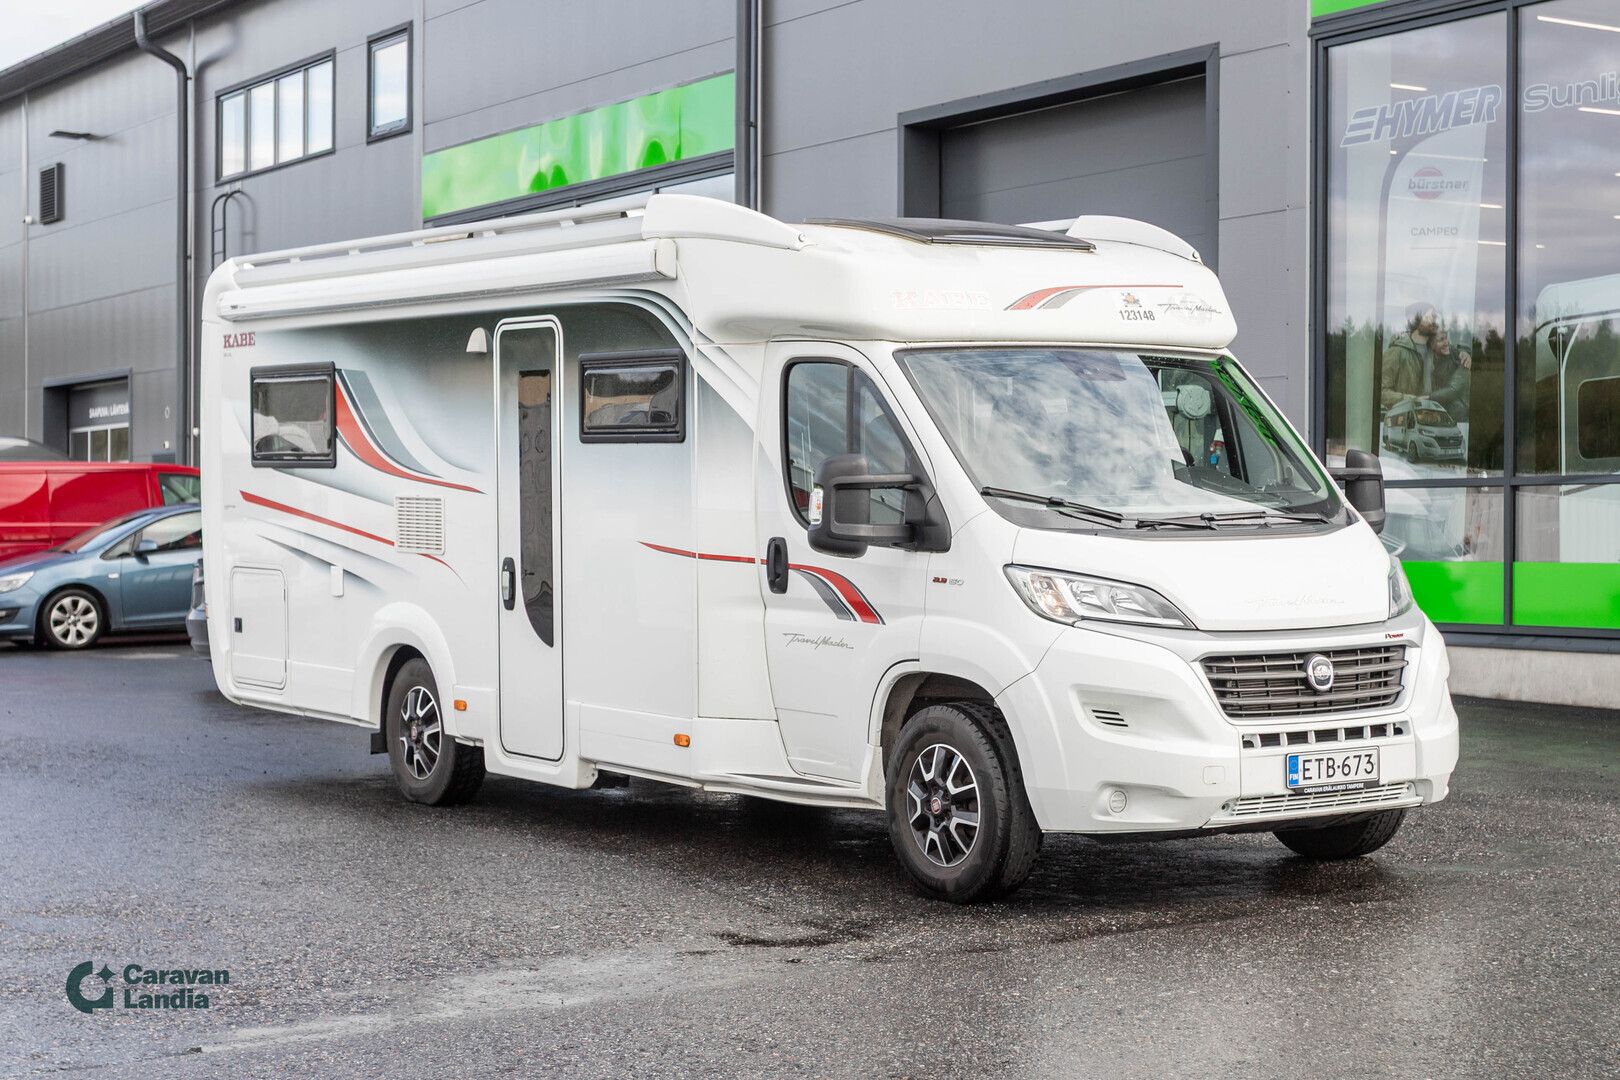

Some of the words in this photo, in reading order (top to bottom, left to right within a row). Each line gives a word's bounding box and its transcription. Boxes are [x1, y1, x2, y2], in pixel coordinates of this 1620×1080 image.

[1523, 71, 1620, 113] Sunli
[1373, 85, 1501, 141] HYMER
[1408, 178, 1468, 190] bürstner
[1119, 309, 1156, 321] 123148
[223, 331, 256, 349] KABE
